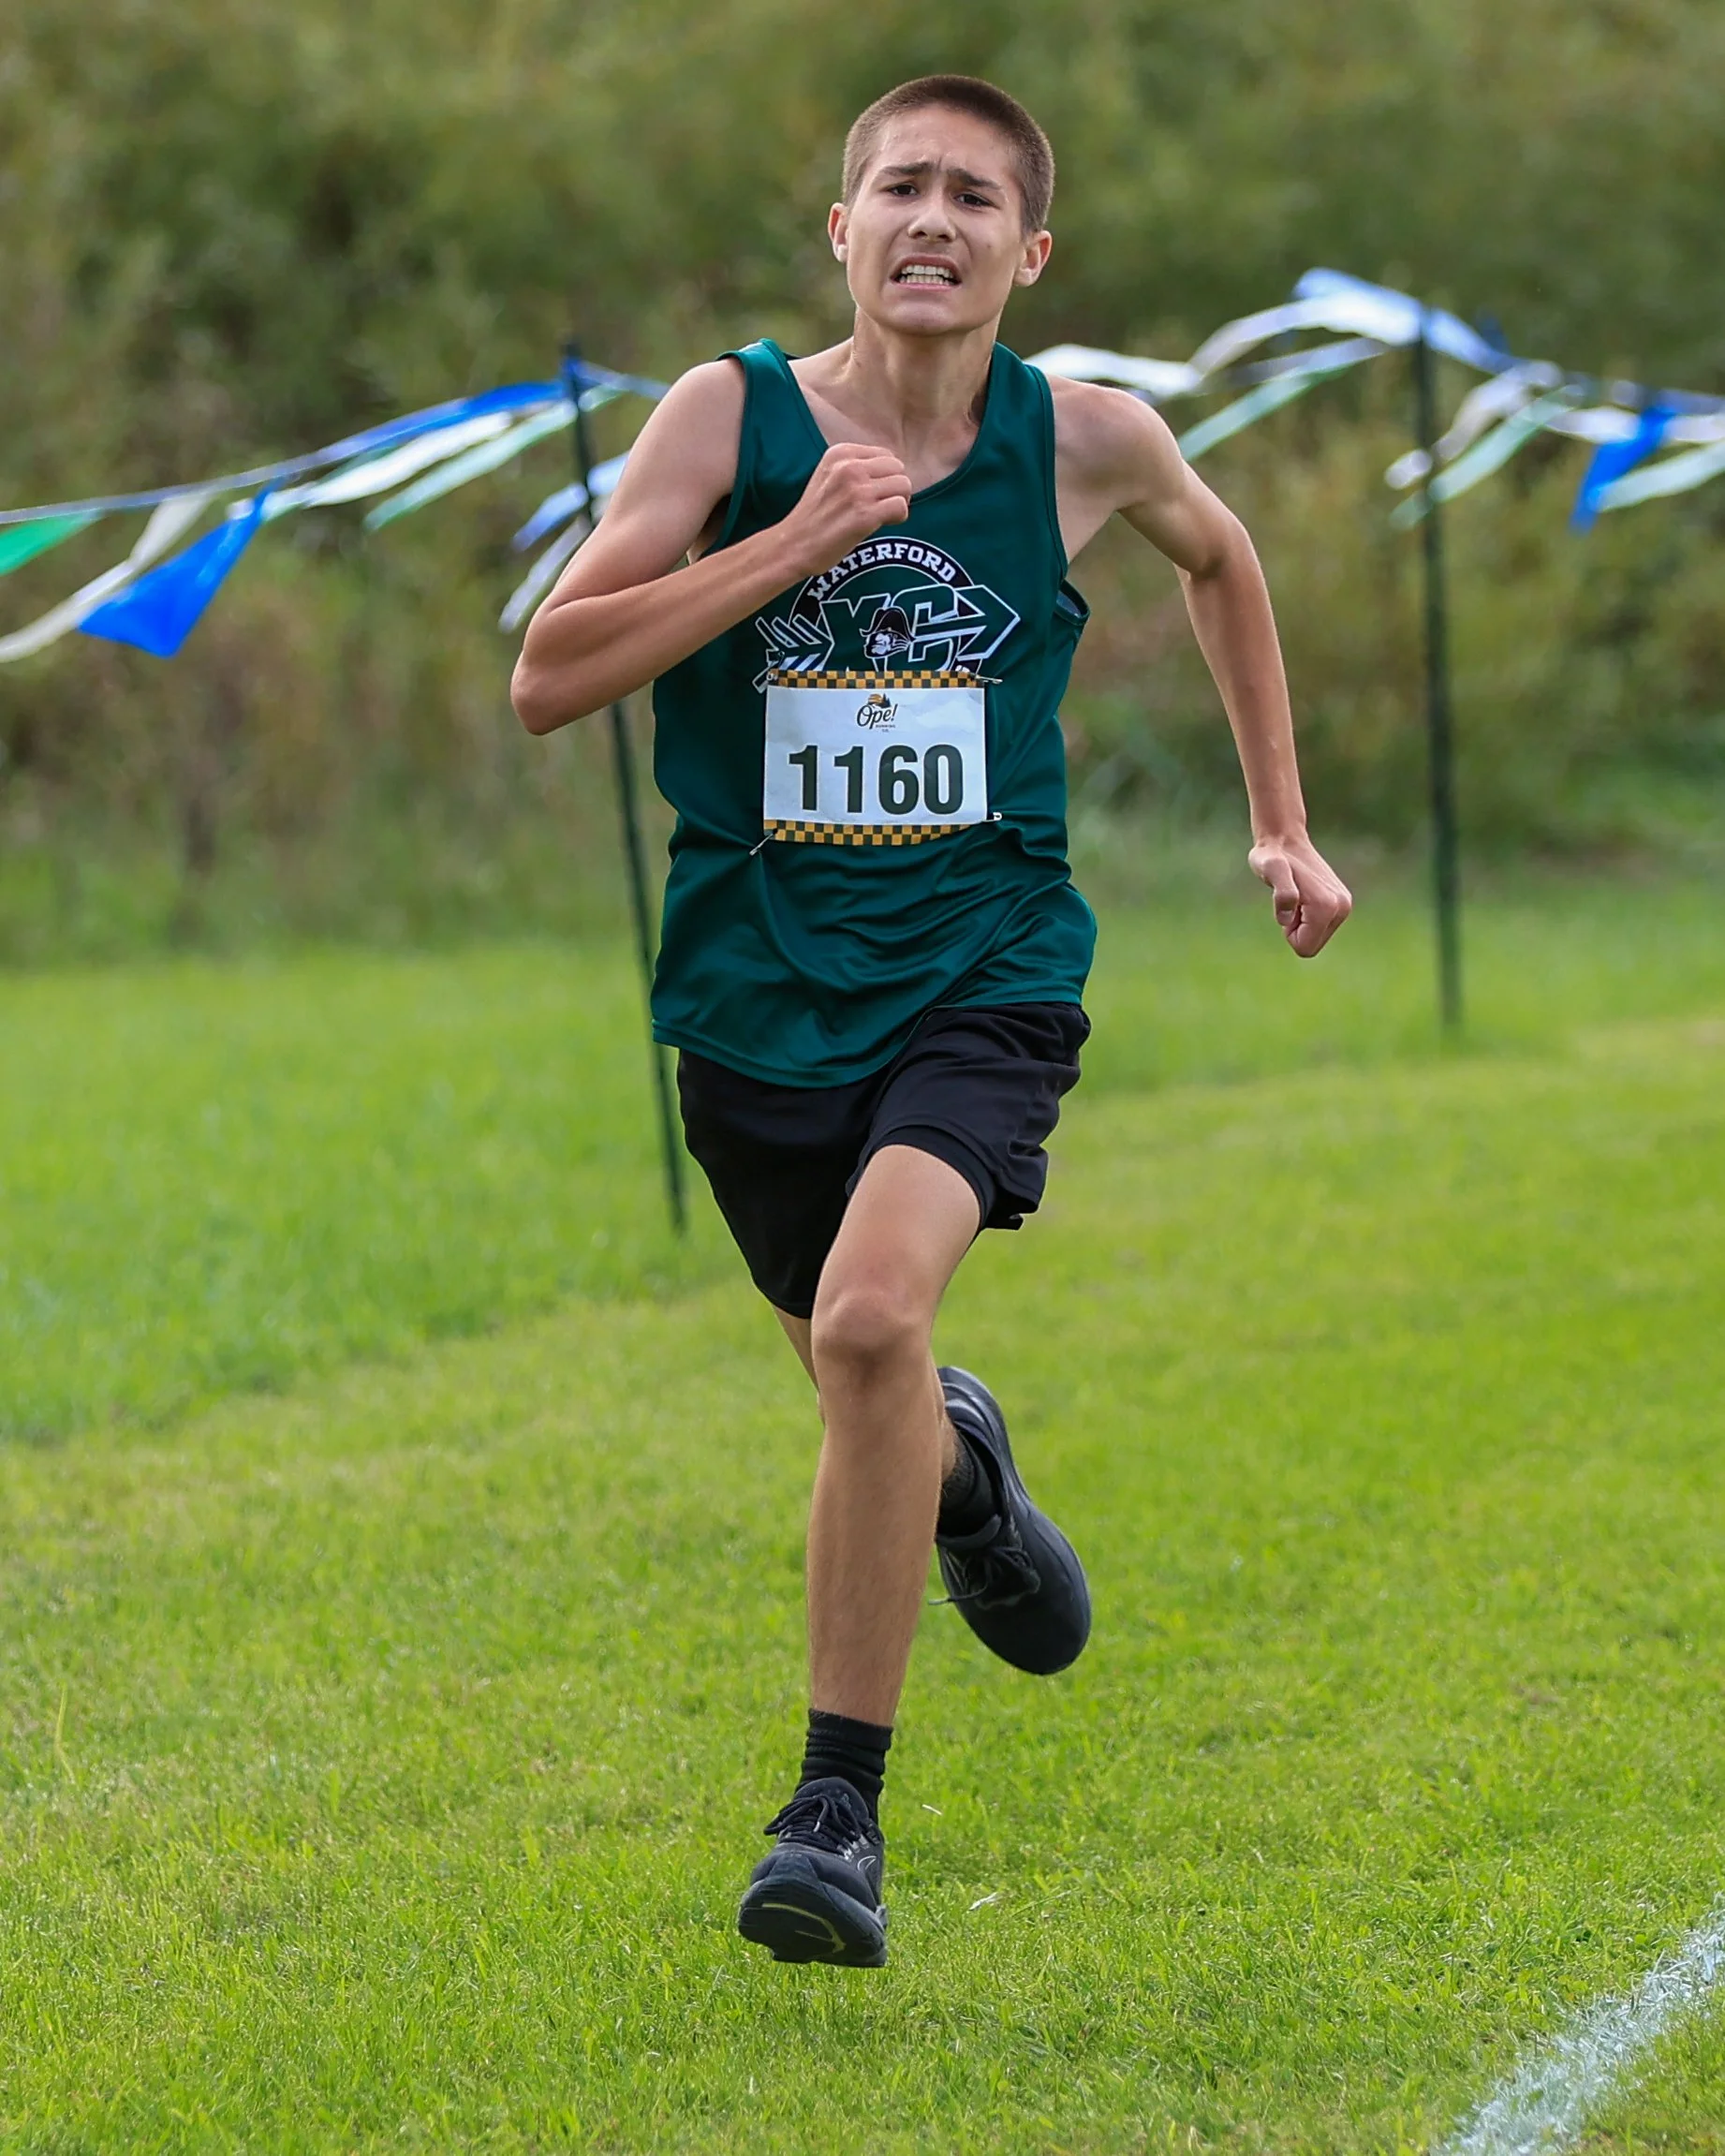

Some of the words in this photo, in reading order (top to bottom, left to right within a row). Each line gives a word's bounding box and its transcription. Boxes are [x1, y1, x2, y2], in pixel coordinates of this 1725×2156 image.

[807, 543, 956, 600] WATERFORD
[856, 703, 898, 730] Ope!
[789, 745, 963, 814] 1160
